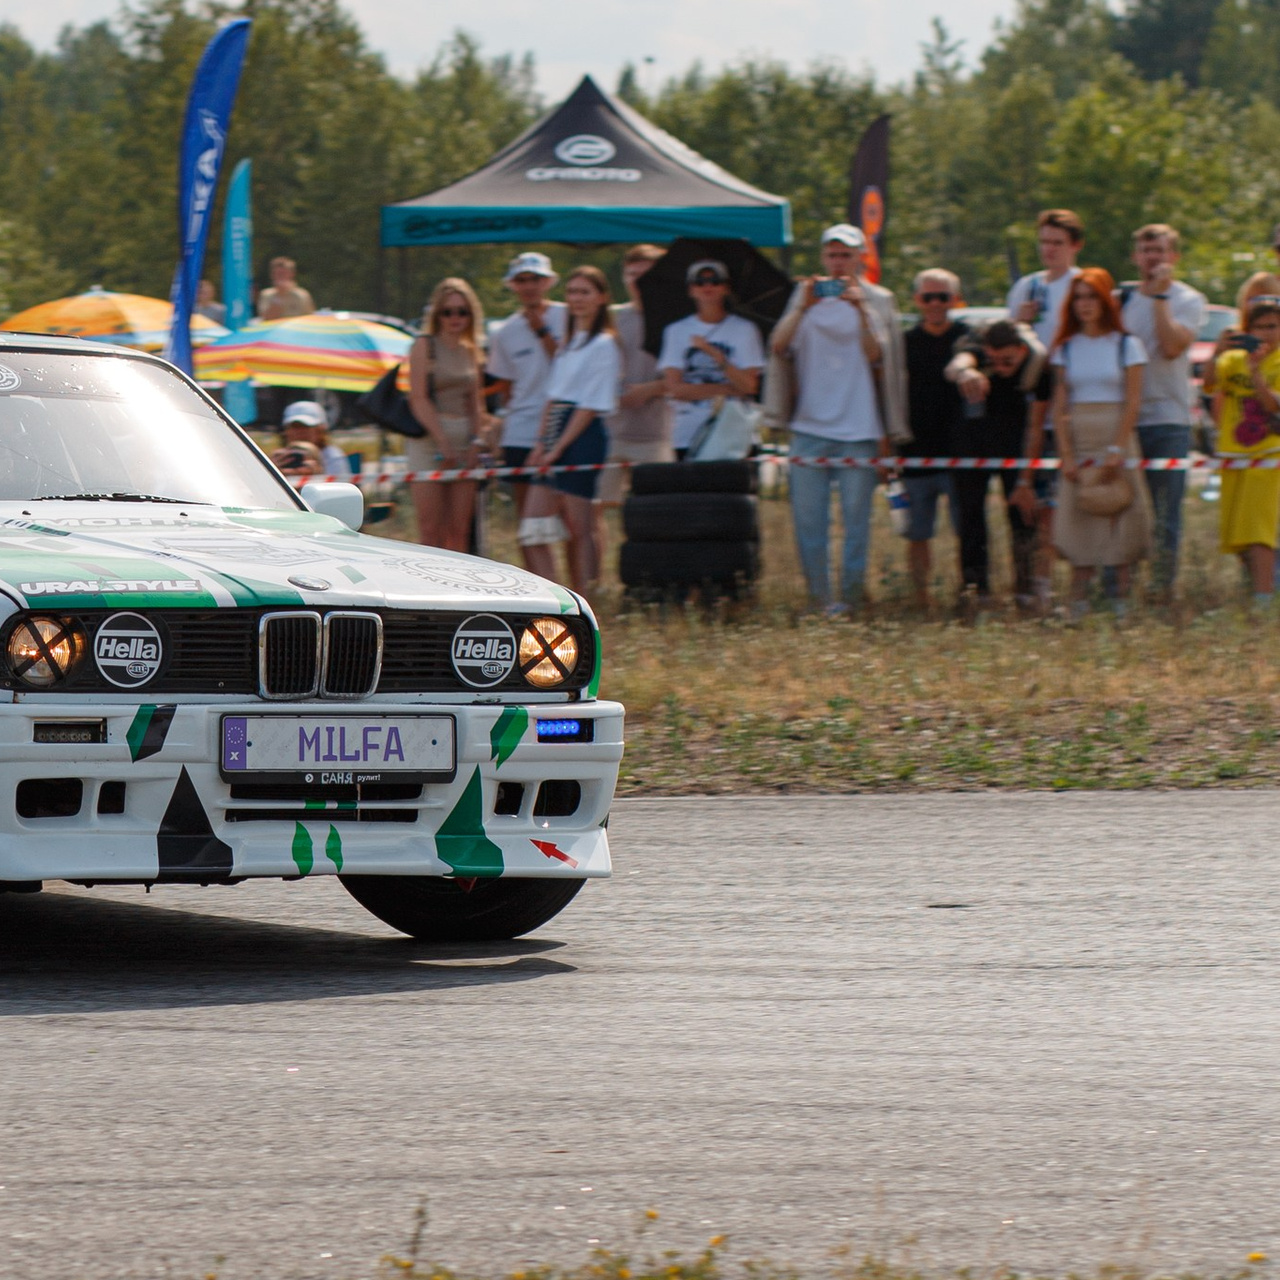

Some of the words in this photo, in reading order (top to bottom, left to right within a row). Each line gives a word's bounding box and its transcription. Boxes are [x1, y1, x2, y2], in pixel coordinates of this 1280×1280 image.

[98, 638, 157, 659] Hella
[455, 638, 512, 660] Hella
[298, 726, 405, 762] MILFA
[321, 772, 354, 785] САНЯ
[357, 774, 381, 783] рулит!
